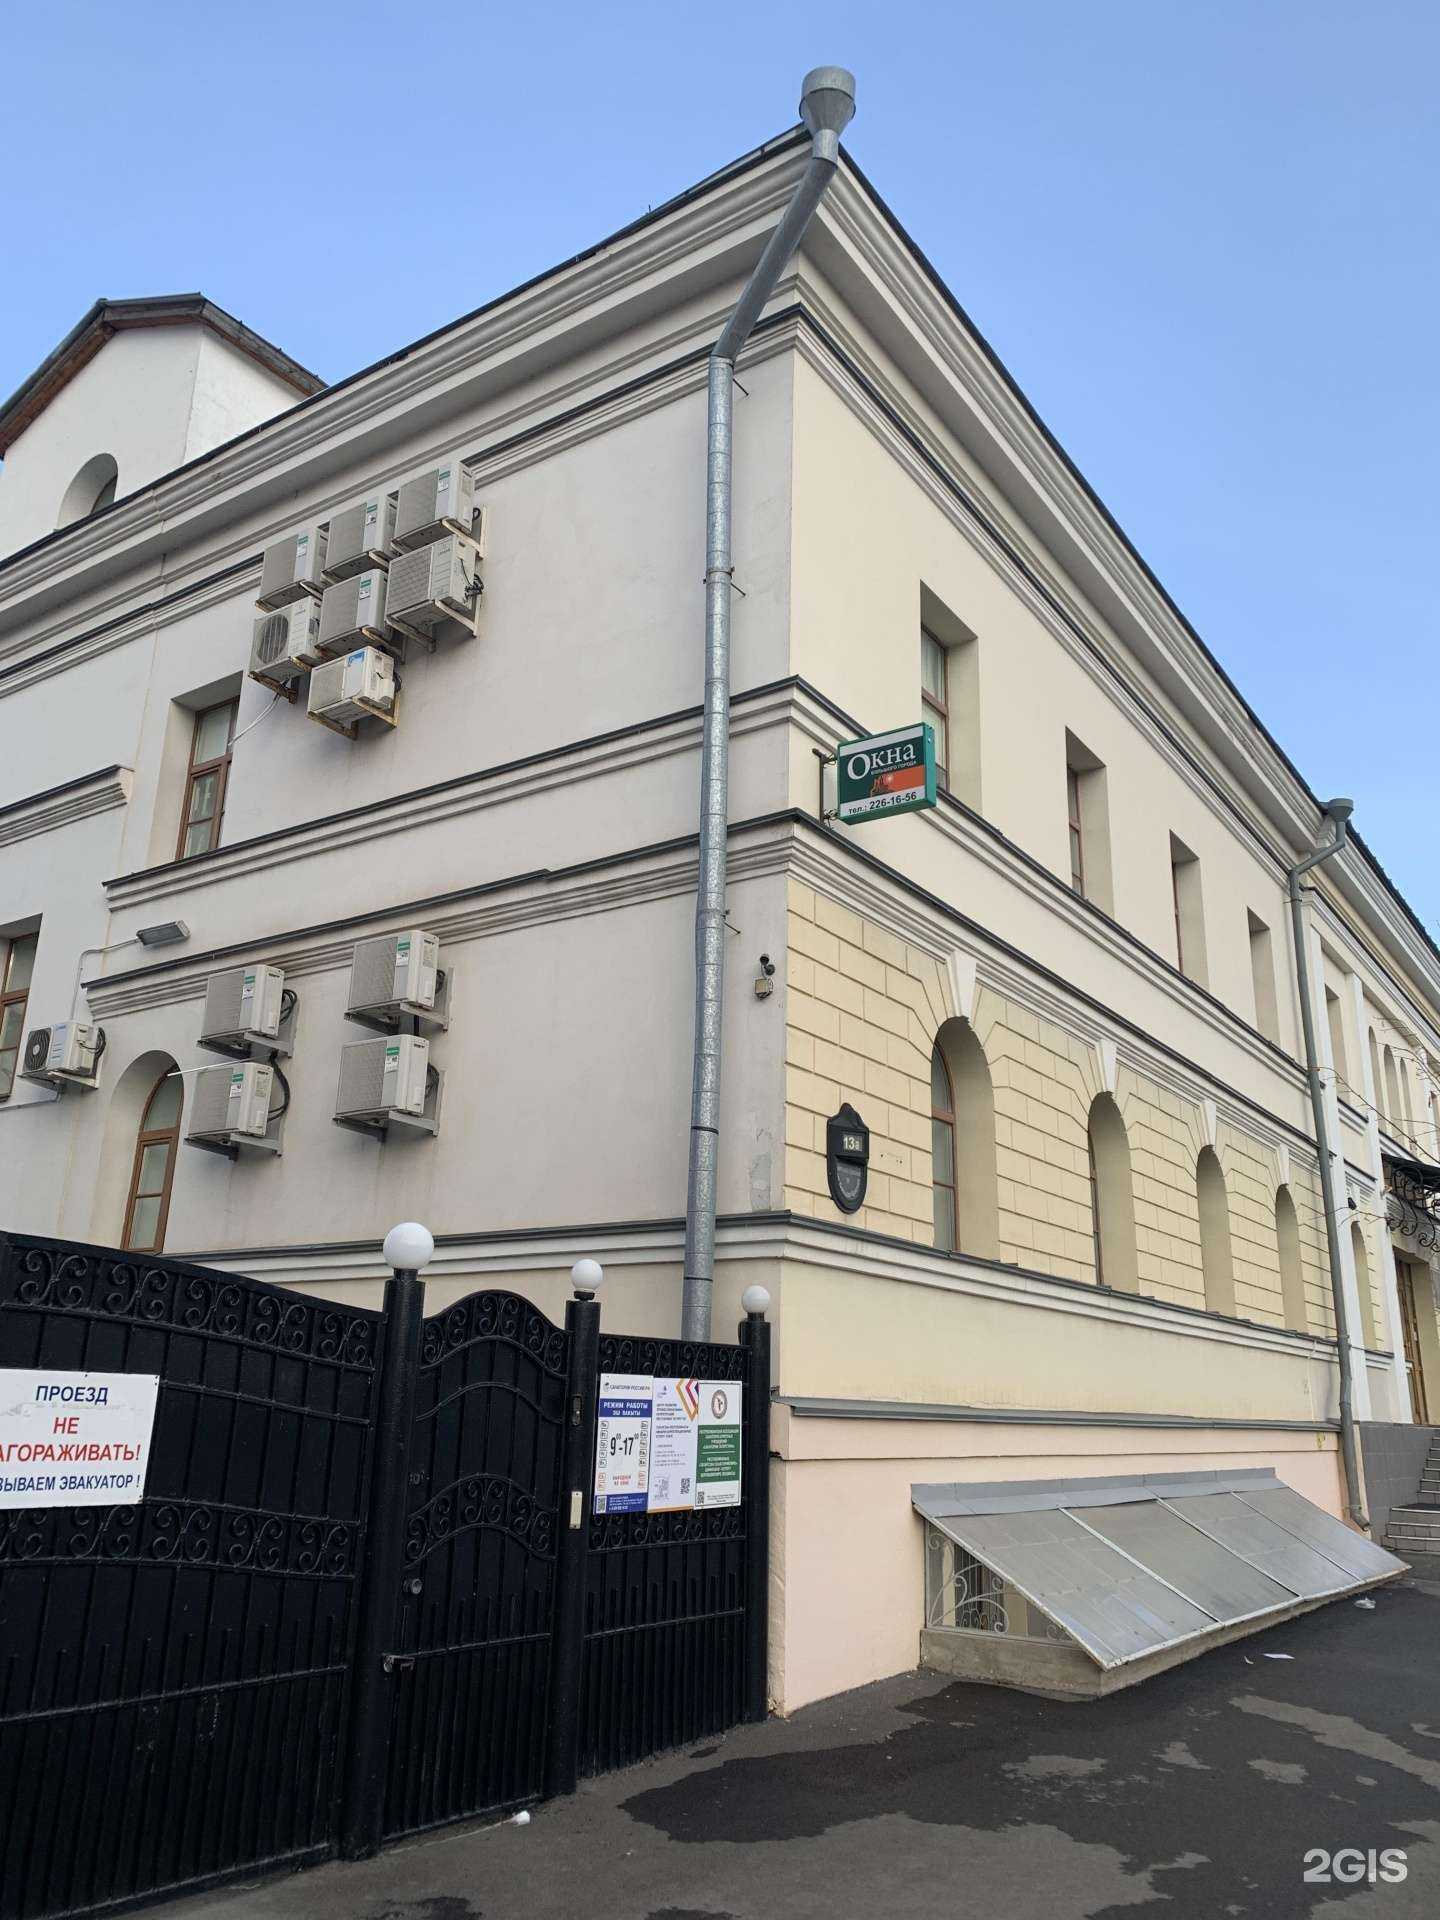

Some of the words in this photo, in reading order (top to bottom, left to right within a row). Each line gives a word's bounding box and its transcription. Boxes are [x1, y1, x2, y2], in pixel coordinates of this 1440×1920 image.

[847, 743, 917, 780] Окна
[869, 791, 917, 810] 226-16-56
[35, 1385, 109, 1406] ПРОЕЗД
[603, 1401, 624, 1409] РЕЖИМ
[53, 1417, 80, 1434] НЕ
[0, 1444, 141, 1462] ГОРАЖИВАТЬ!
[59, 1475, 133, 1490] ЭВАКУАТОР
